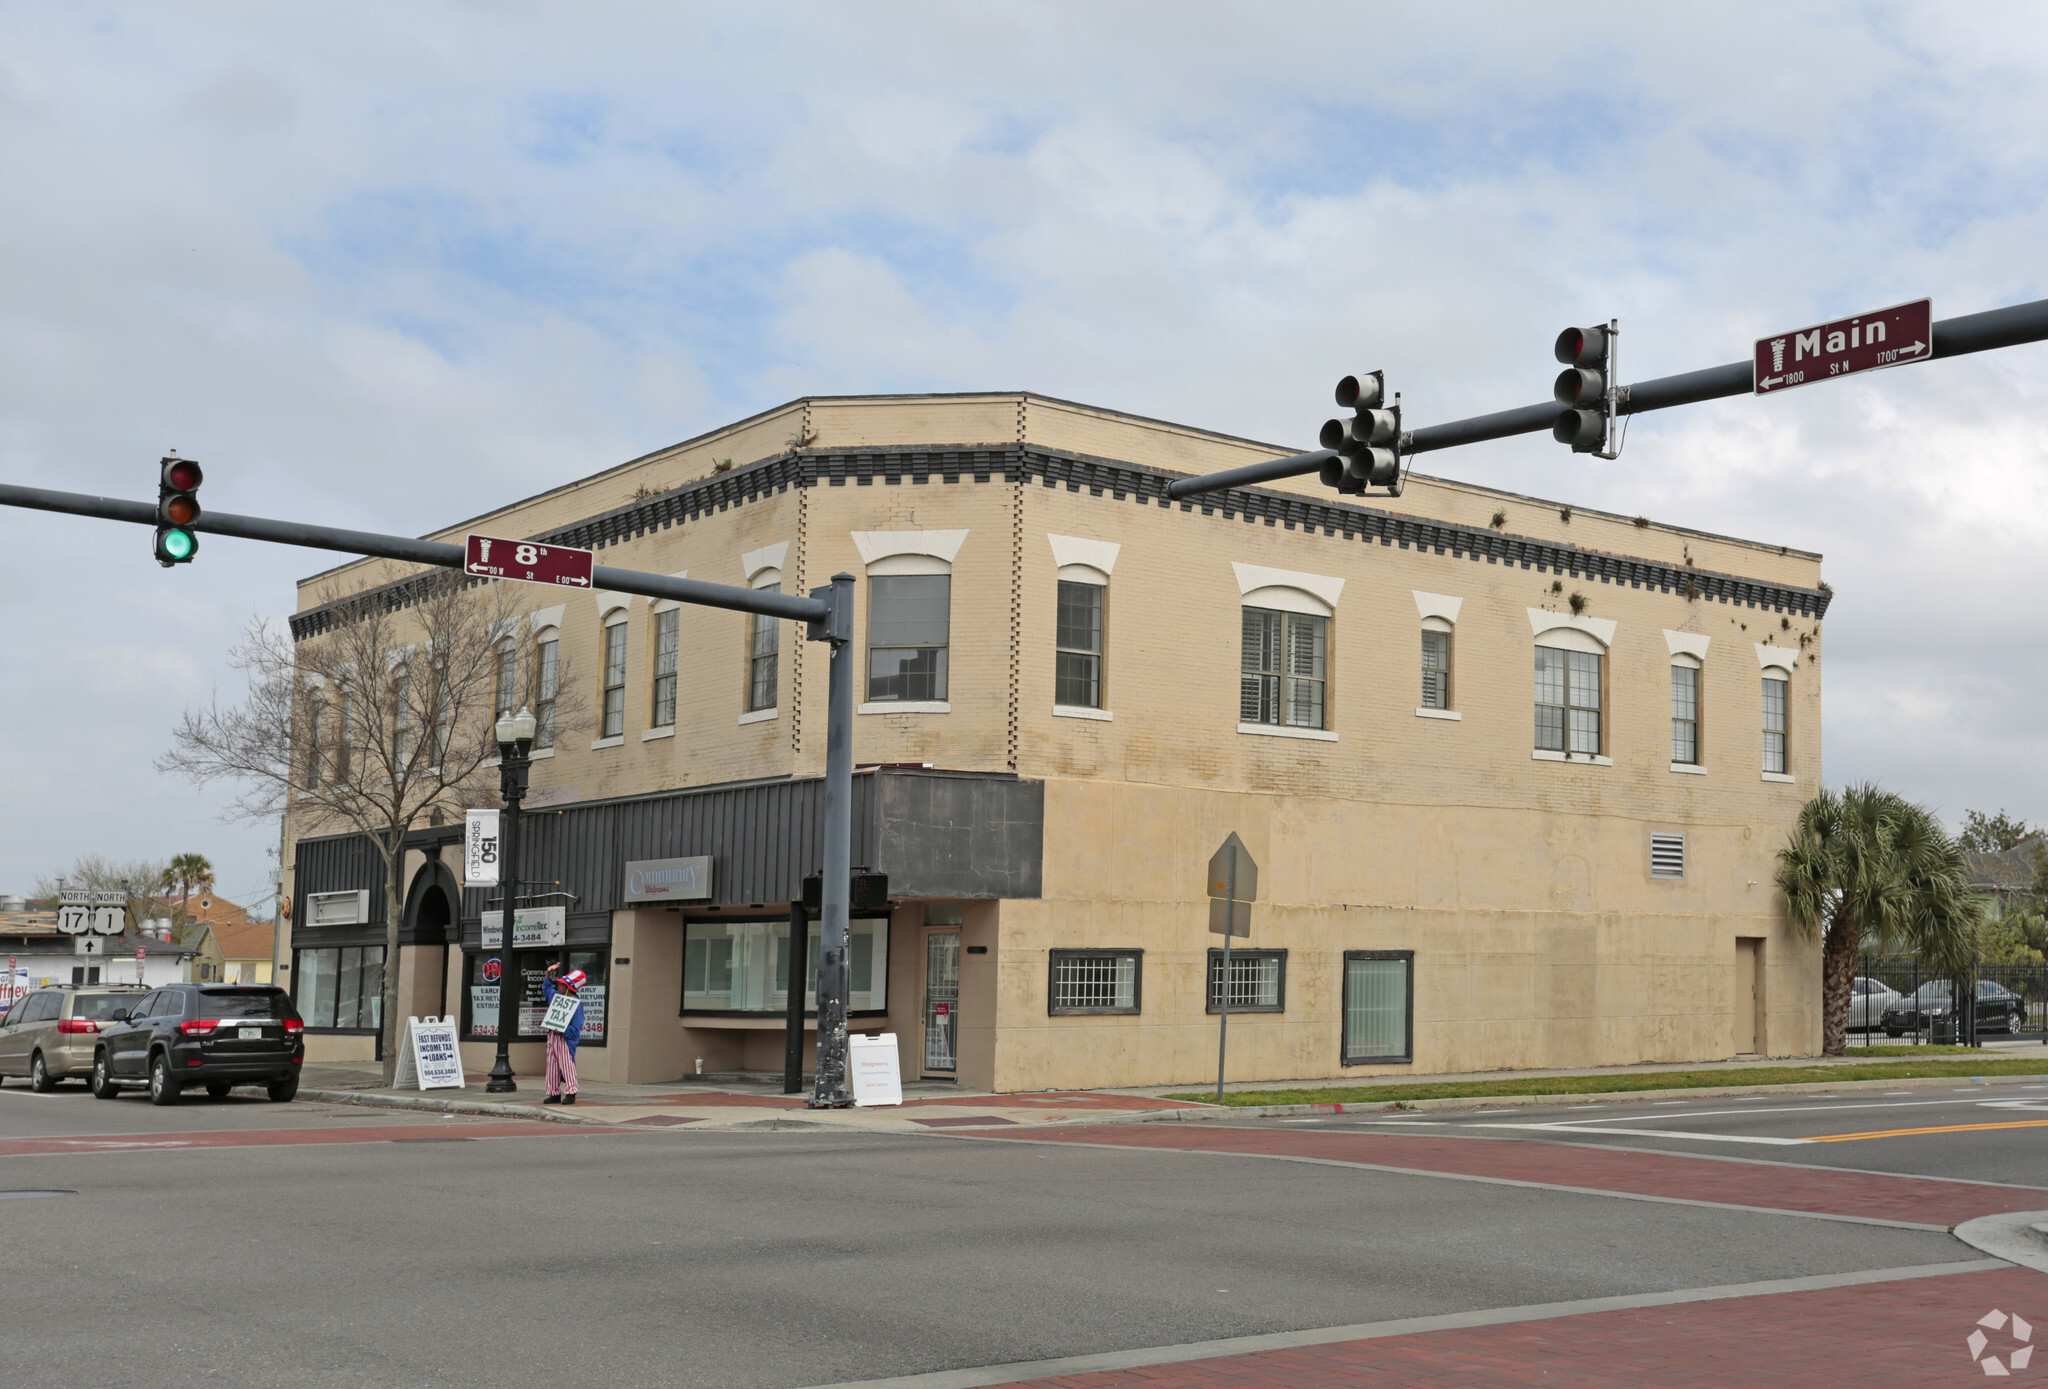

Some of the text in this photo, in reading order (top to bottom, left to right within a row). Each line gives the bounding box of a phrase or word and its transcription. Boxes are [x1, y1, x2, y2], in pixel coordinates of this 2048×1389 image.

[1795, 319, 1886, 362] Main
[1877, 350, 1898, 364] 1700
[1830, 360, 1850, 375] St N
[1785, 371, 1804, 385] 1800
[515, 544, 548, 565] 8th
[498, 567, 505, 576] W
[526, 571, 534, 580] St
[556, 575, 560, 583] E
[471, 821, 481, 878] SPRINGFIELD
[481, 836, 497, 864] 150
[60, 891, 90, 901] NORTH
[97, 893, 126, 902] NORTH
[65, 912, 84, 928] 17
[107, 913, 113, 929] 1
[483, 963, 502, 978] OPEN
[552, 996, 577, 1011] FAST
[550, 1008, 569, 1023] TAX
[473, 1025, 499, 1035] 634-34
[418, 1033, 451, 1043] FAST REFUNDS
[420, 1043, 453, 1053] INCOME TAX
[428, 1053, 448, 1062] LOANS
